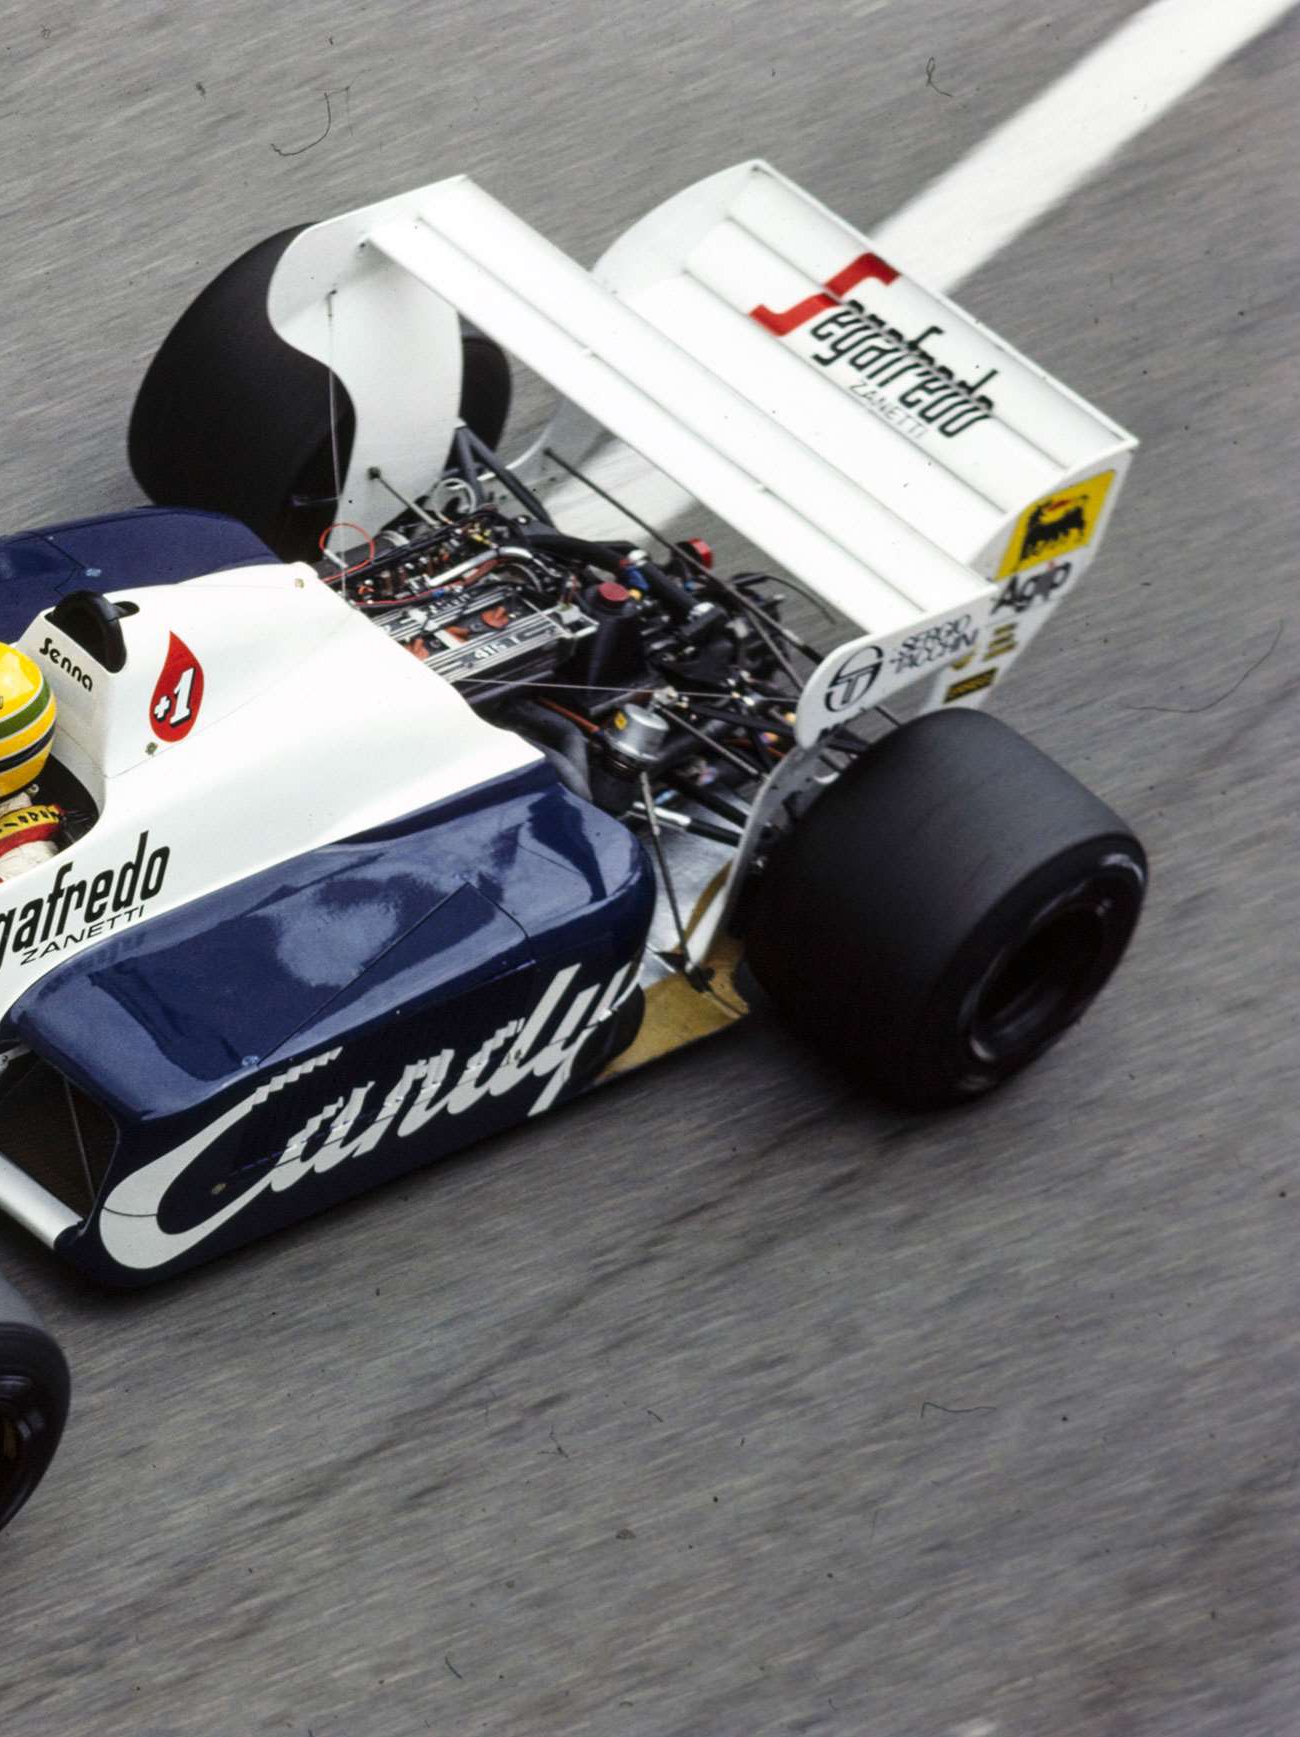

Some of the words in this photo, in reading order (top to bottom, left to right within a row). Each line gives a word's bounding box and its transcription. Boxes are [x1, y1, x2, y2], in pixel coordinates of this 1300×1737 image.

[749, 252, 999, 438] Segafredo
[850, 382, 928, 438] ZANETTI
[39, 637, 94, 693] Senna
[19, 904, 145, 966] ZANETTI
[100, 962, 637, 1269] Candy
